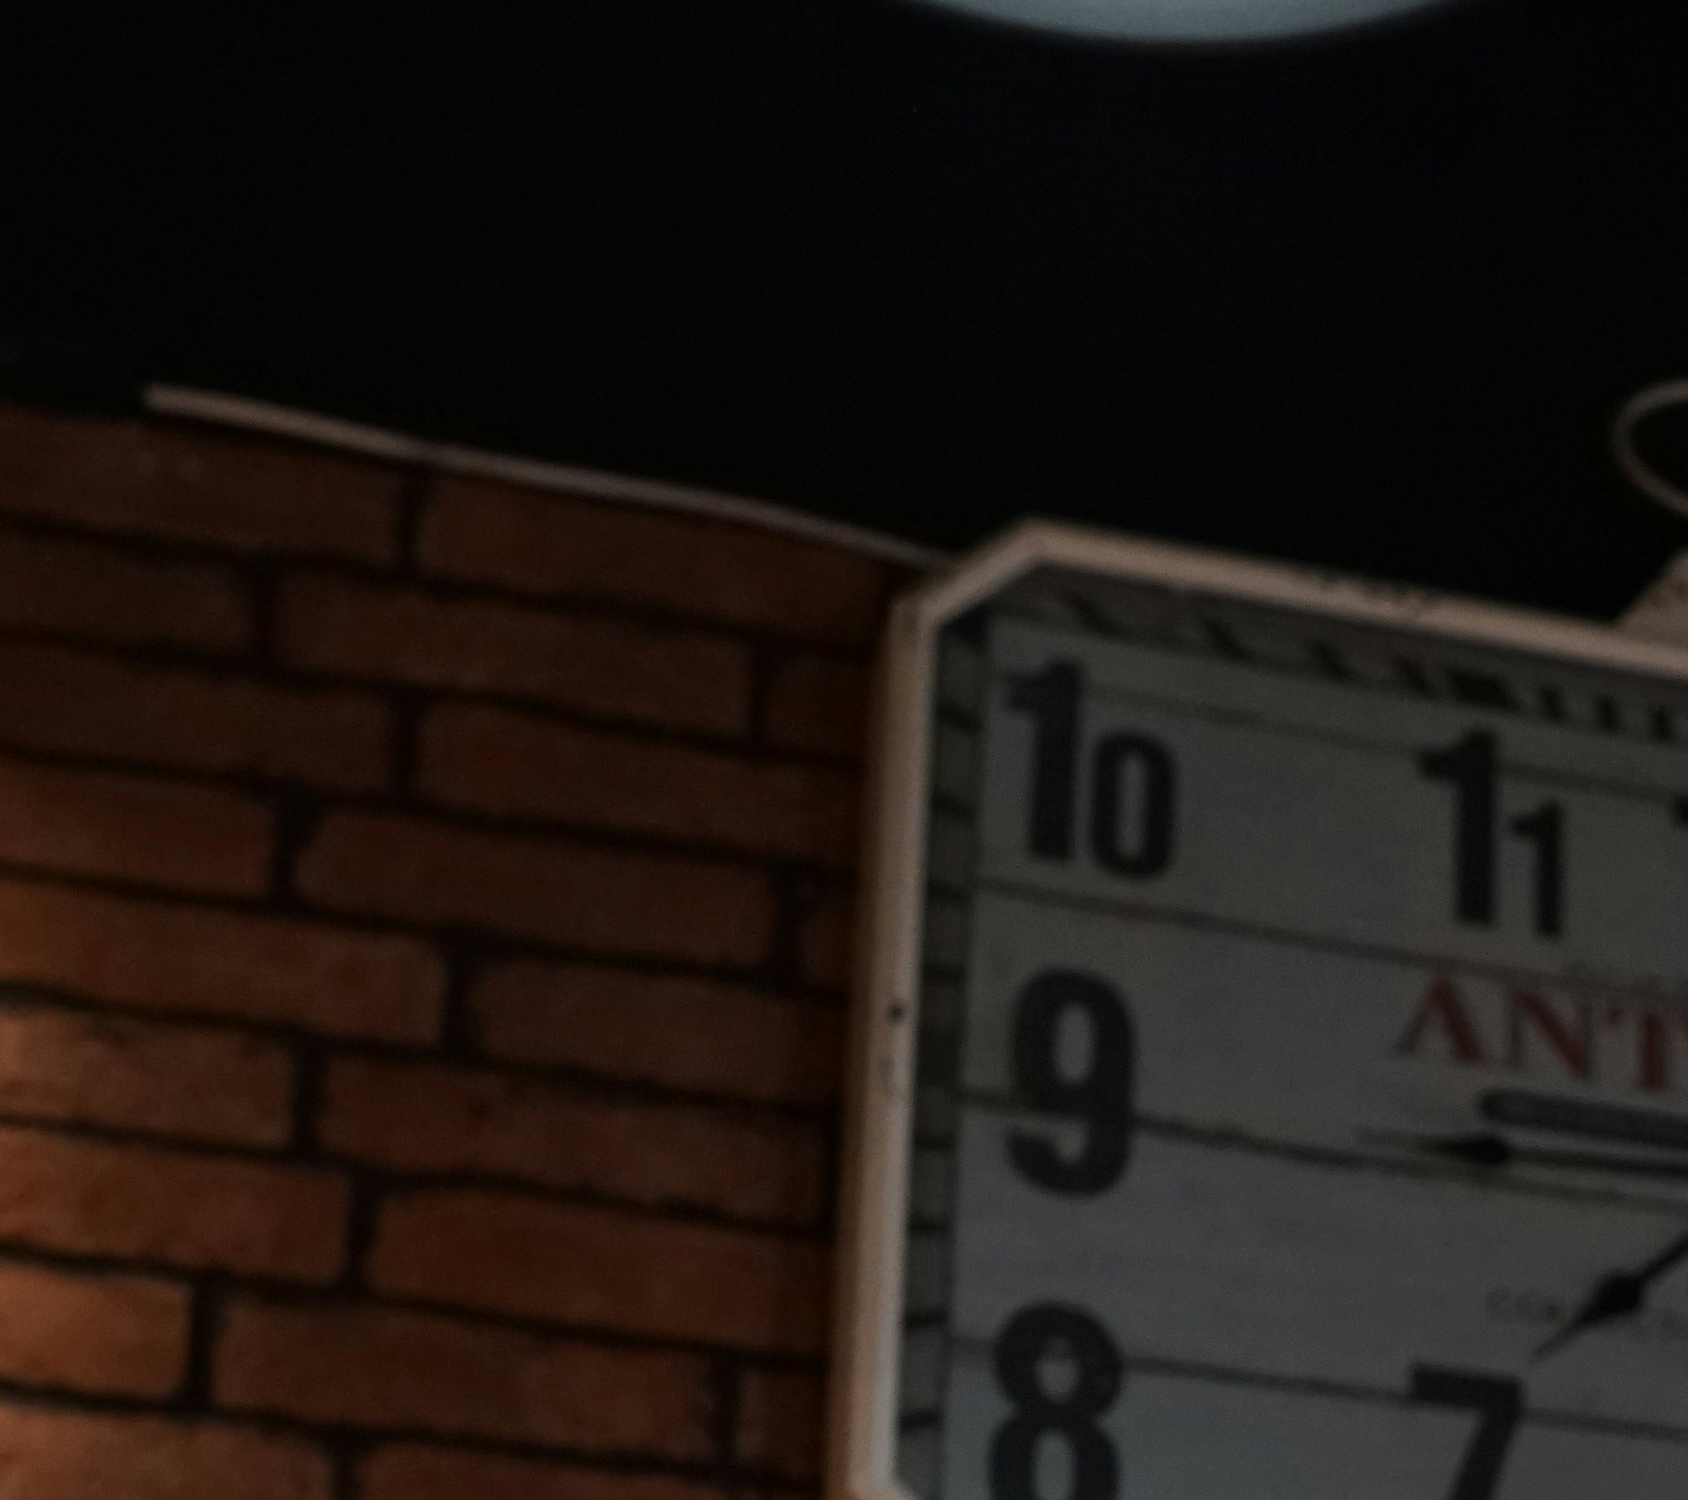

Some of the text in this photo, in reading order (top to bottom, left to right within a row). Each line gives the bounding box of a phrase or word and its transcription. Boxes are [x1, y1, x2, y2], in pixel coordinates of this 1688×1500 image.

[1003, 660, 1176, 880] 10
[1418, 728, 1562, 938] 11
[1006, 968, 1136, 1198] 9
